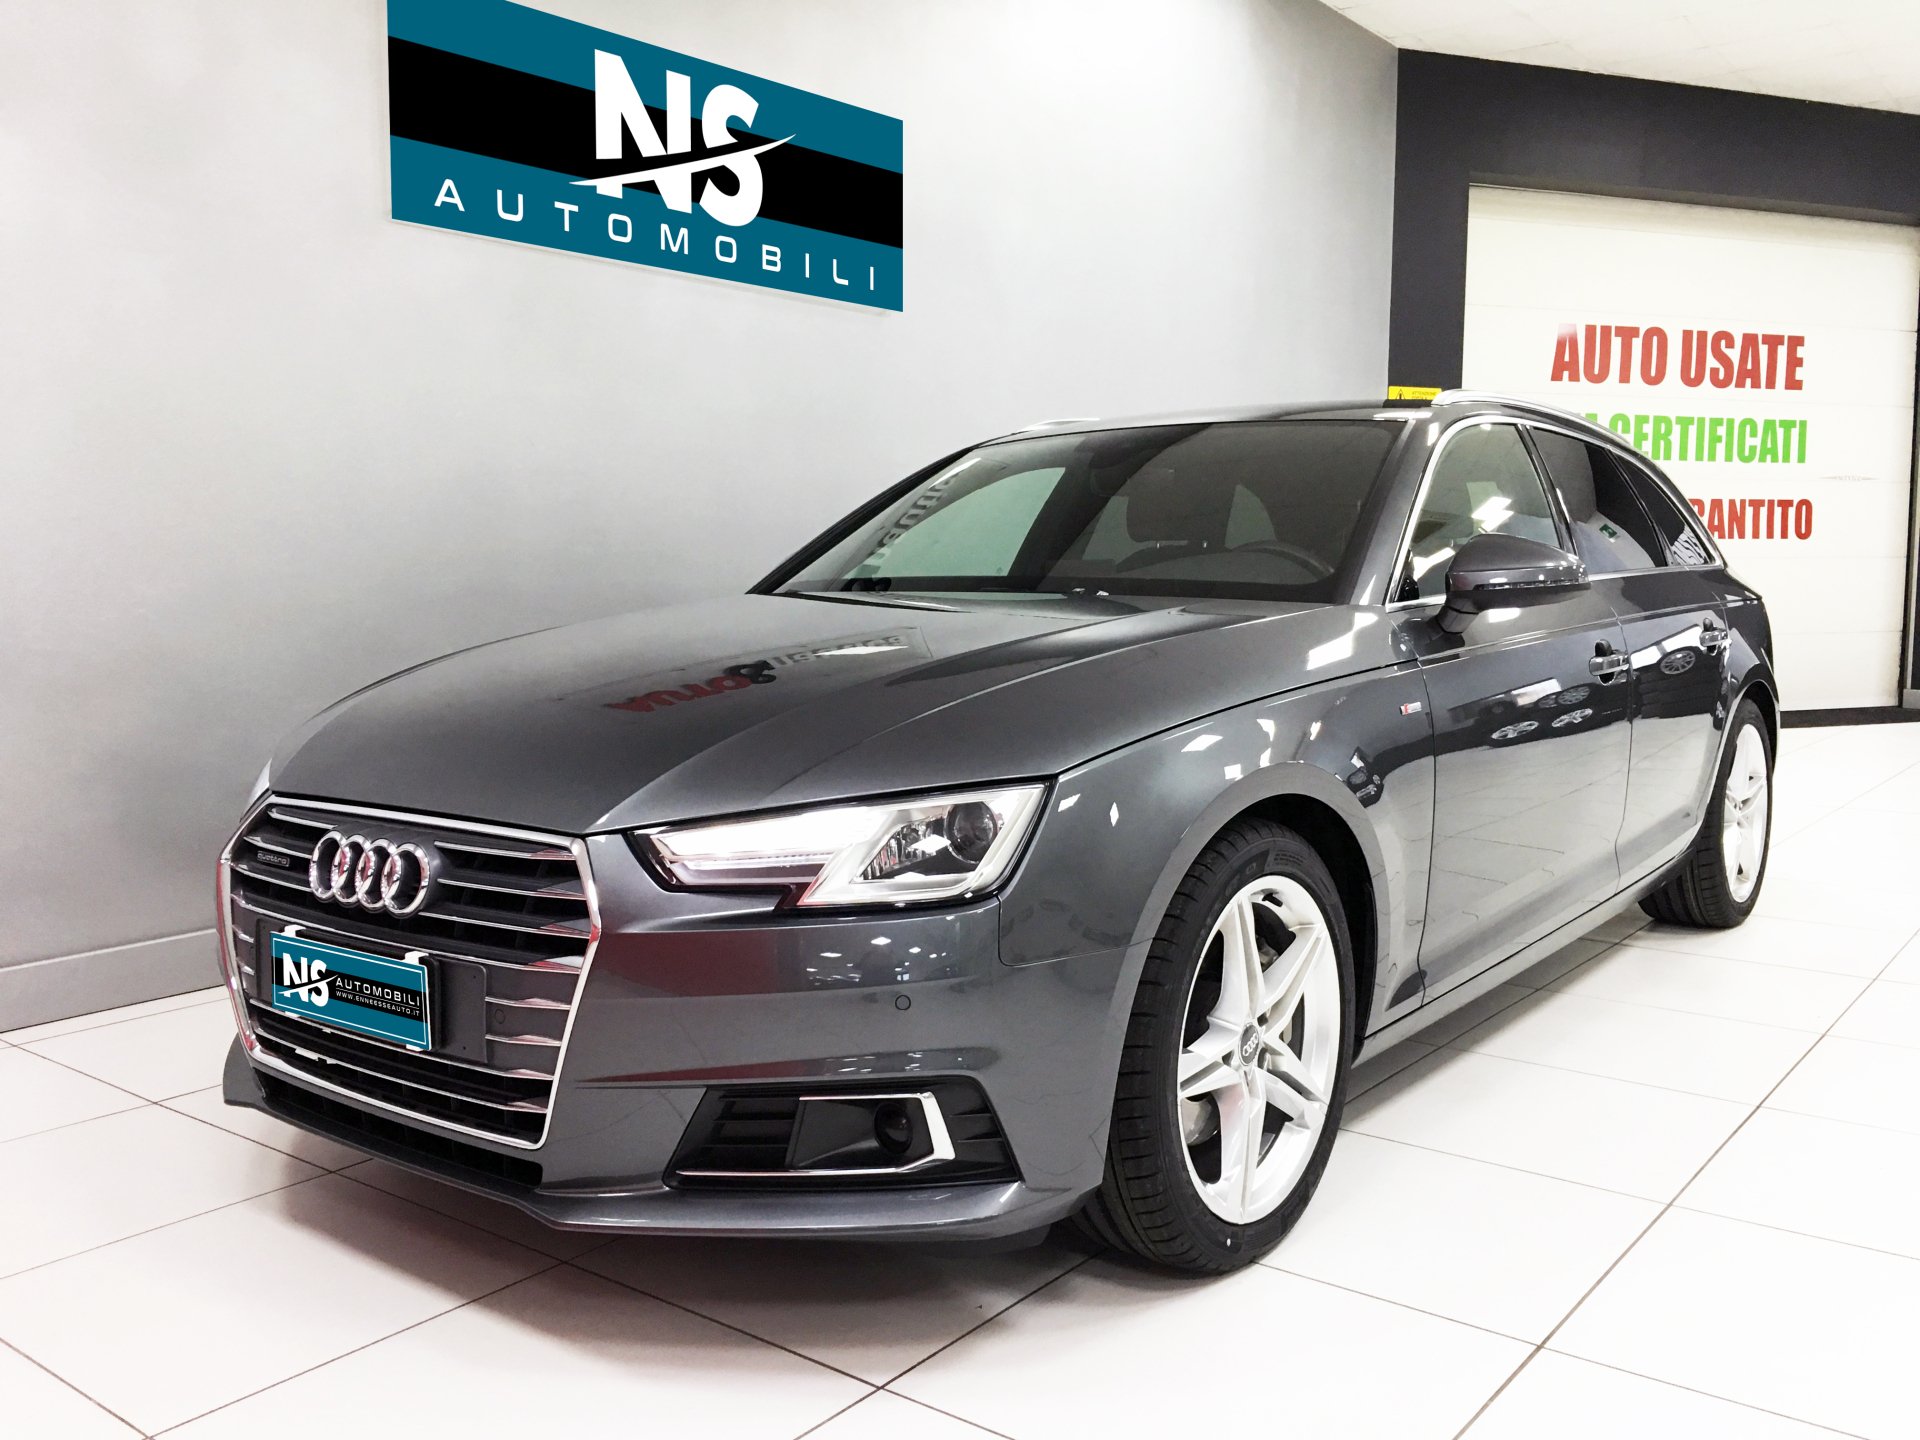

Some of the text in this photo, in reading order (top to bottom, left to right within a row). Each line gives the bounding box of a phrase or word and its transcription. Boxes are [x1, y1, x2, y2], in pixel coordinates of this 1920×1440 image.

[594, 48, 764, 227] NS
[433, 178, 875, 291] AUTOMOBILI
[1550, 323, 1805, 391] AUTO USATE
[256, 851, 288, 866] quattro
[282, 952, 330, 1007] NS
[335, 977, 420, 1007] AUTOMOBILI
[335, 990, 420, 1017] WWW.ENNEESSEAUTO.IT
